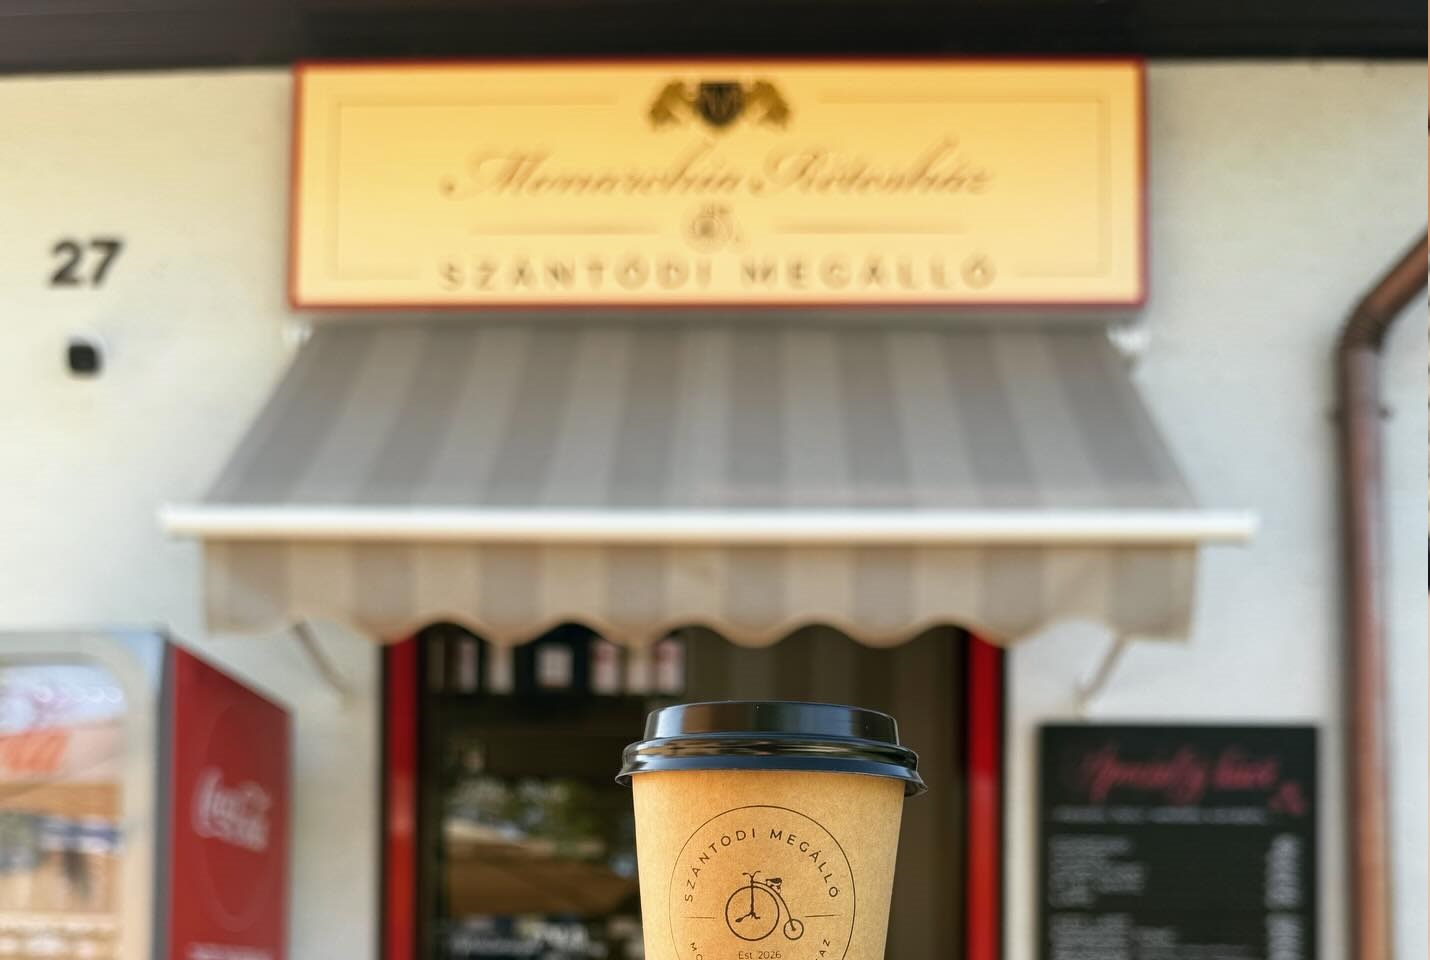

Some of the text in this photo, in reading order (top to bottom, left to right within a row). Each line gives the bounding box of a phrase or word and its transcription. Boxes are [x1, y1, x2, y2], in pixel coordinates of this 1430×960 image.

[48, 236, 123, 289] 27
[684, 827, 841, 903] SZÁNTÓDI MEGÁLLÓ
